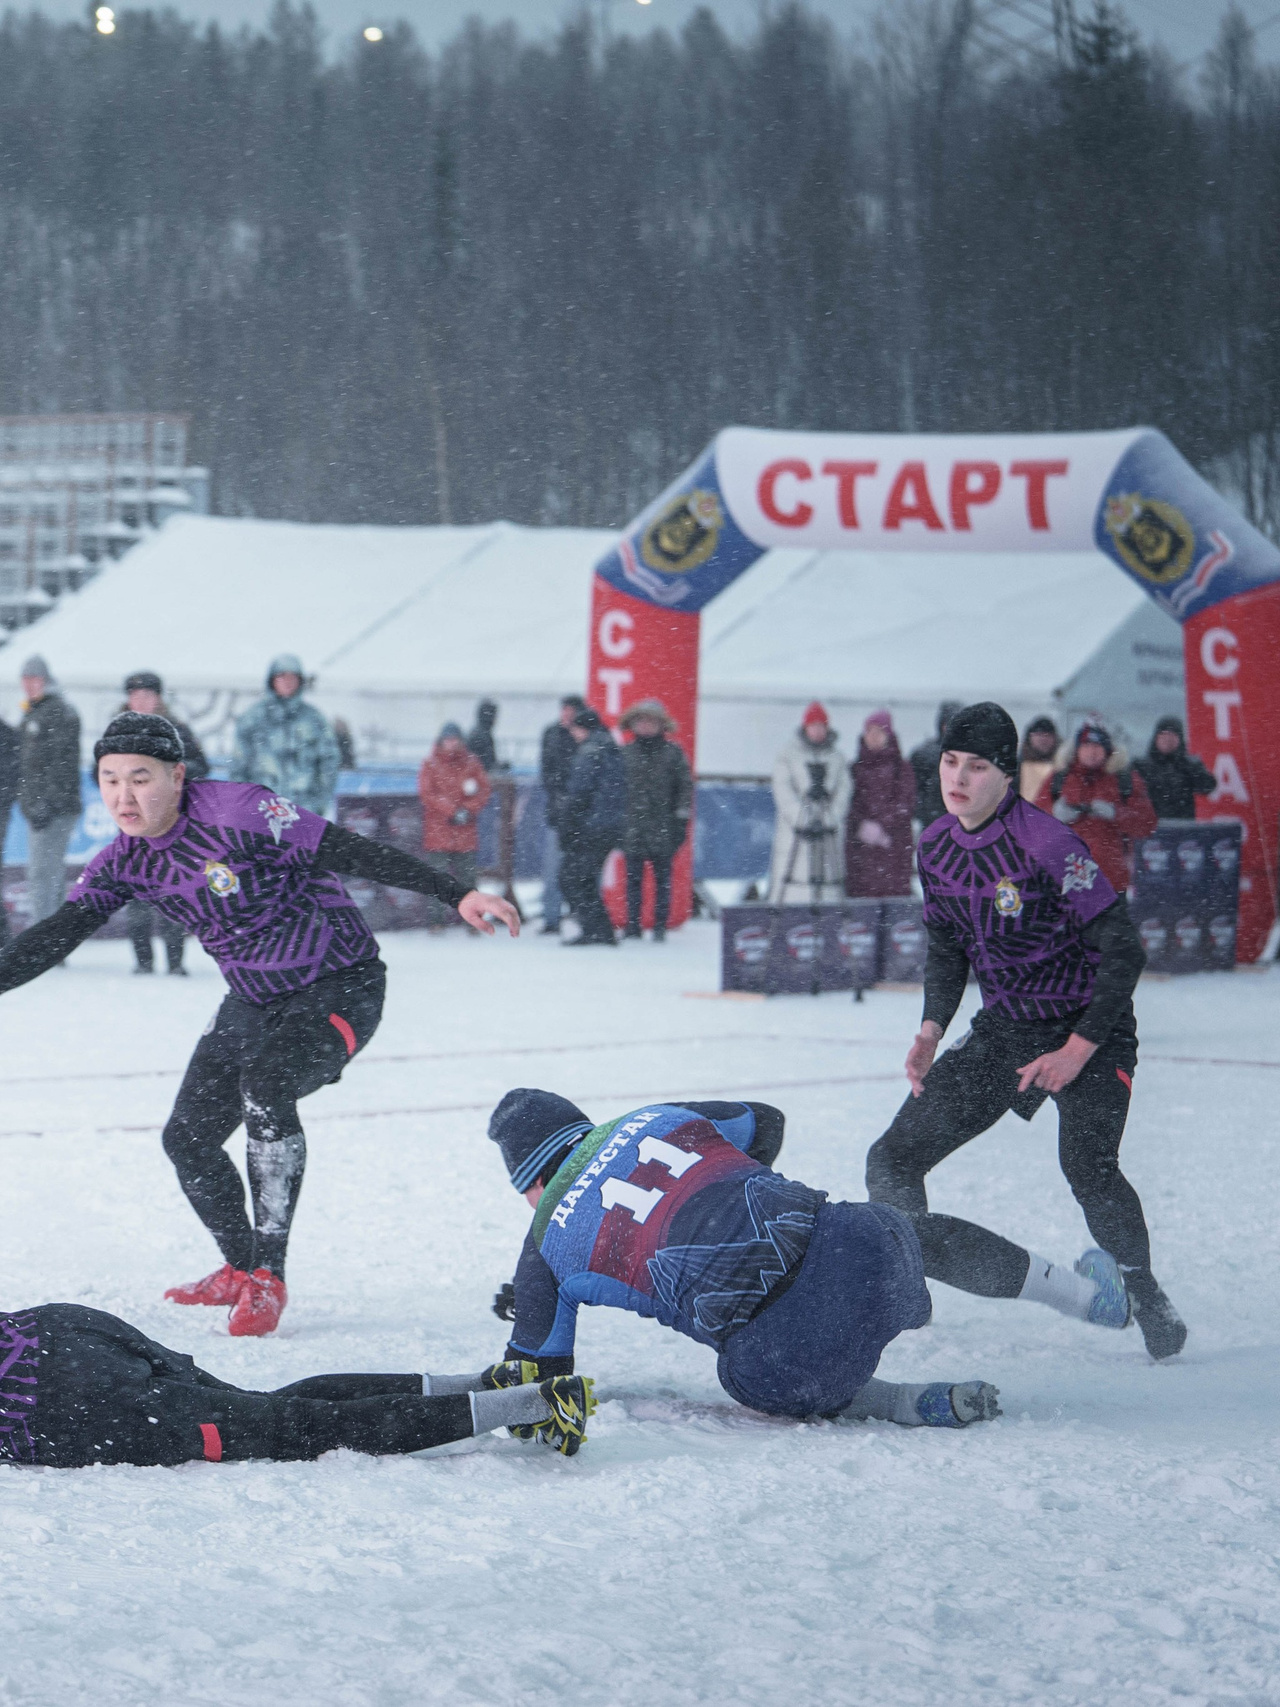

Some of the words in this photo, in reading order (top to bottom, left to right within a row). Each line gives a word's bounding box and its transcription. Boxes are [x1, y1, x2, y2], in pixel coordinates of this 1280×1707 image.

[757, 457, 1069, 532] СТАРТ
[597, 609, 634, 747] СТ
[550, 1112, 663, 1229] ДАГЕСТАН
[599, 1135, 704, 1225] 11
